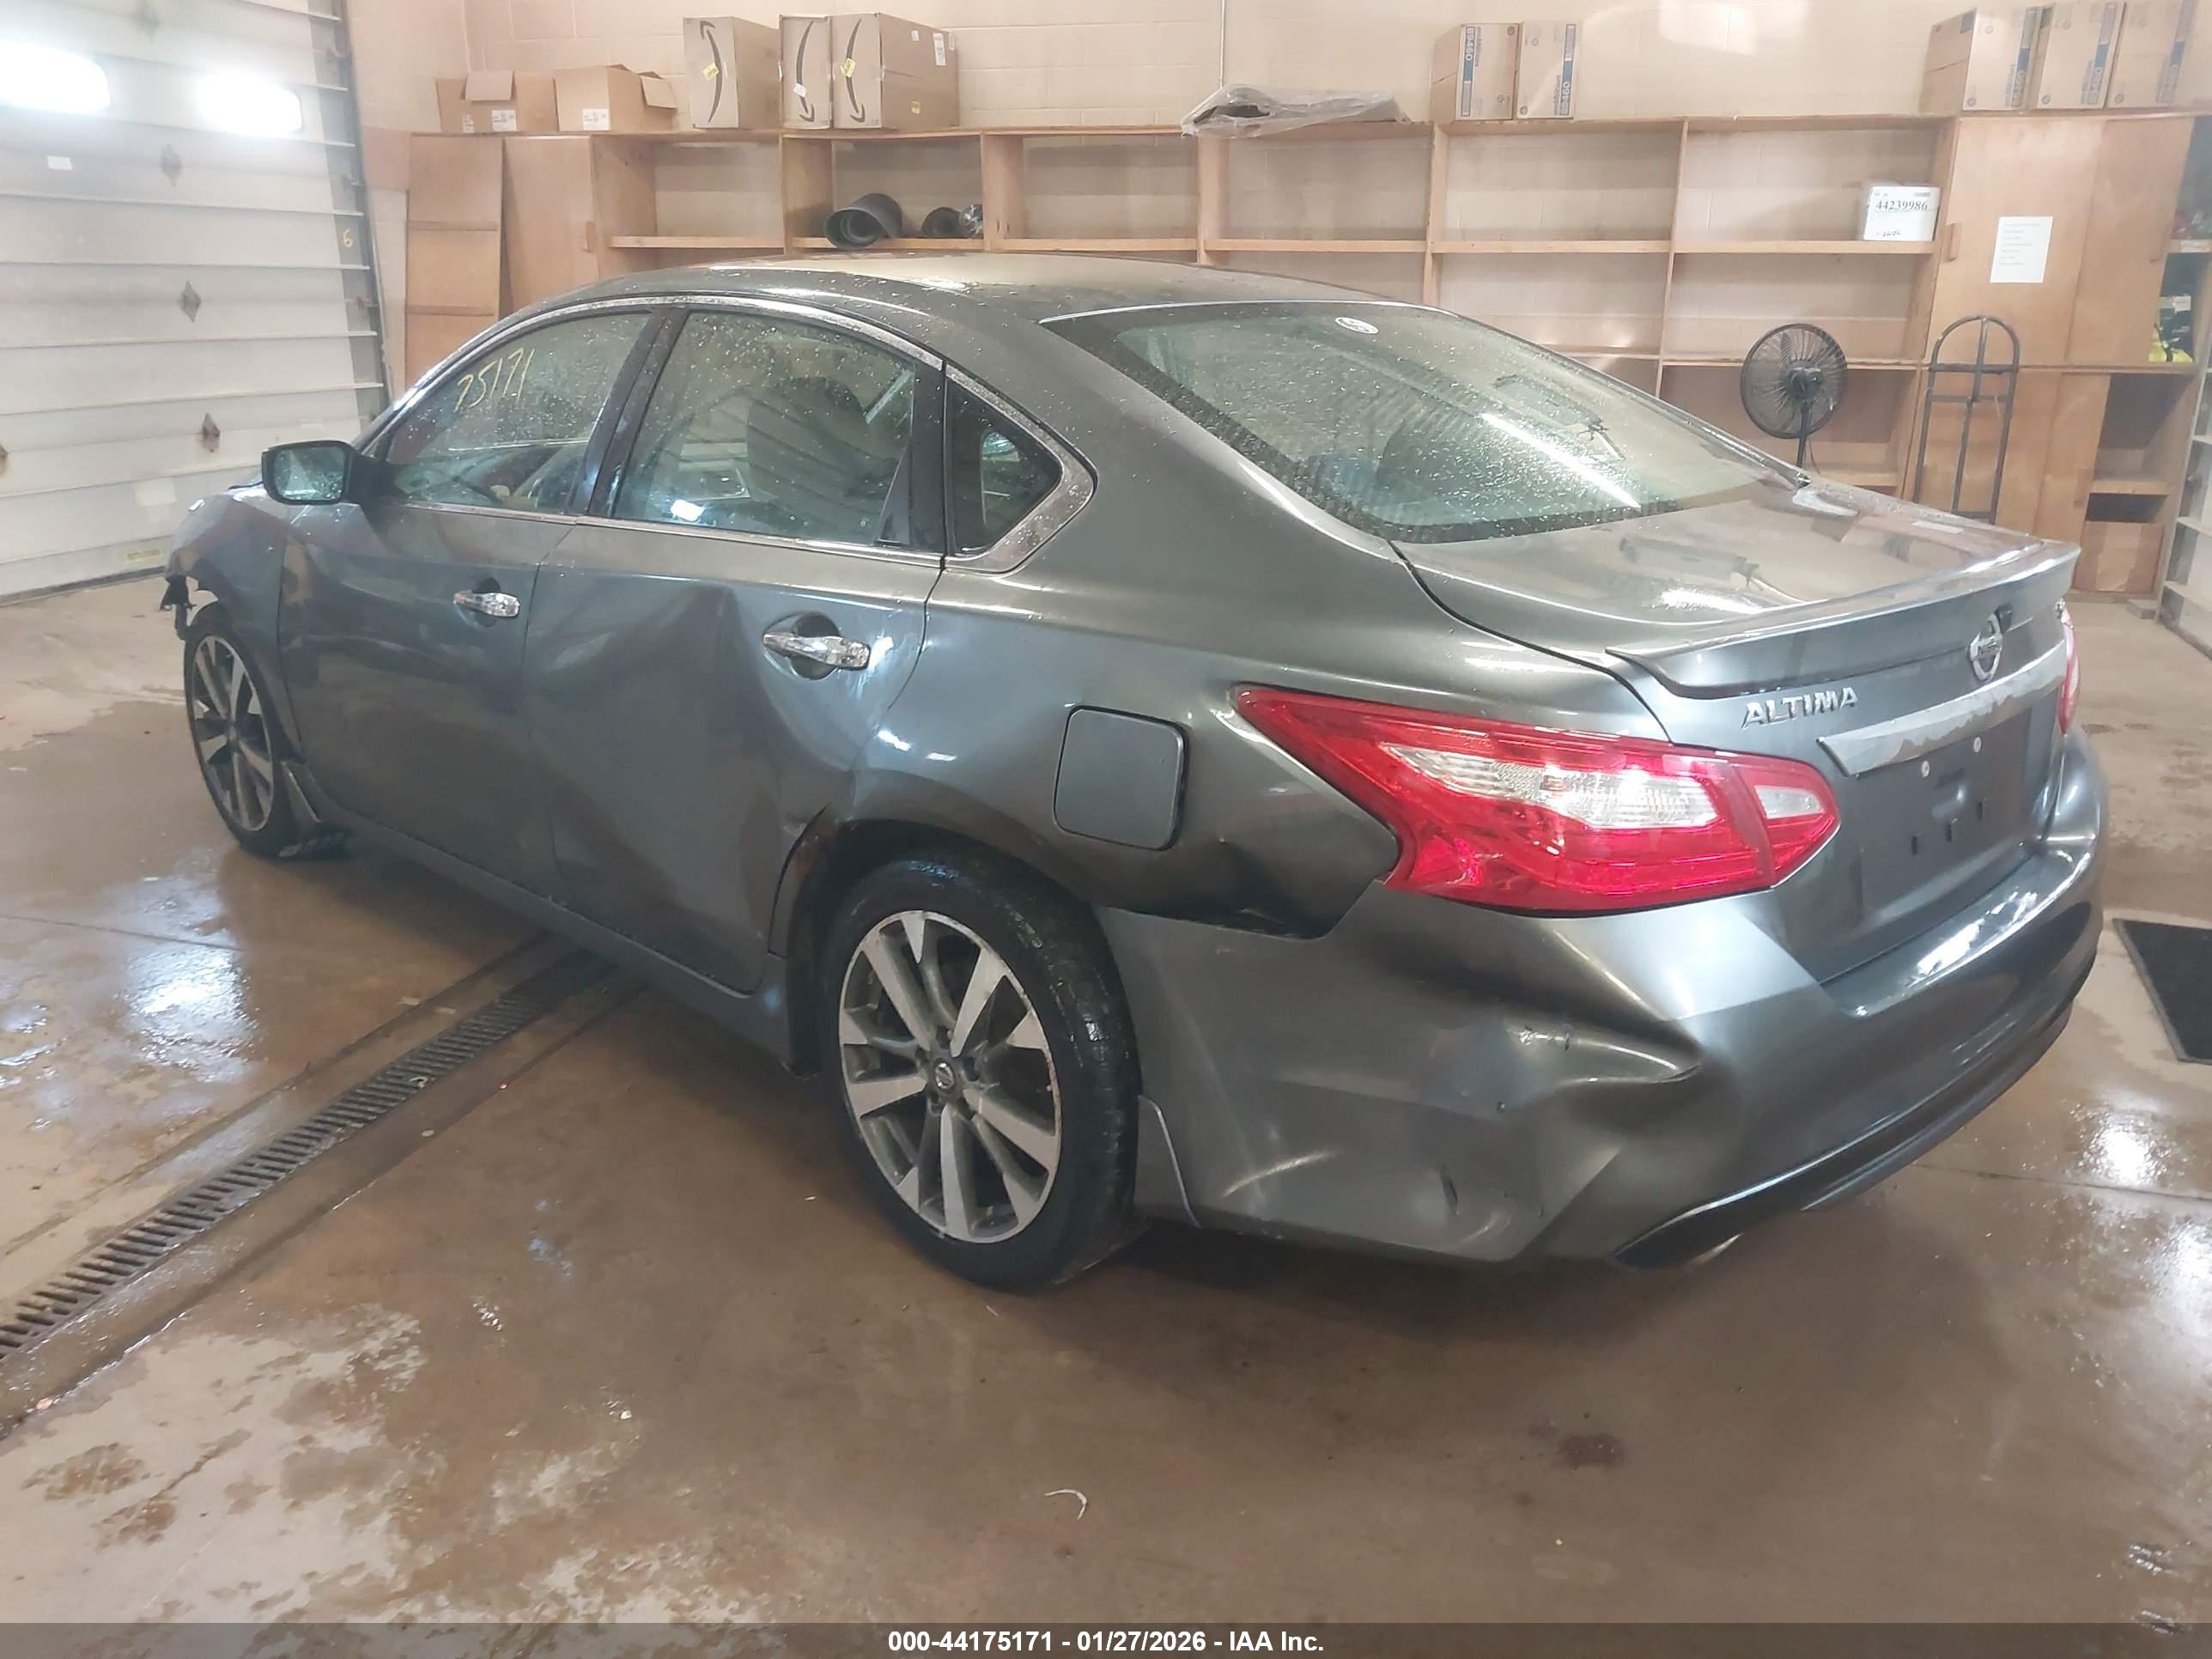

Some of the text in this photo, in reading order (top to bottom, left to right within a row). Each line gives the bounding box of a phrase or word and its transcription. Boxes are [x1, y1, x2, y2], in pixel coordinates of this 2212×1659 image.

[1875, 200, 1929, 211] 44239986
[343, 228, 353, 248] 6
[453, 347, 536, 413] 75171
[1742, 686, 1859, 729] ALTIMA
